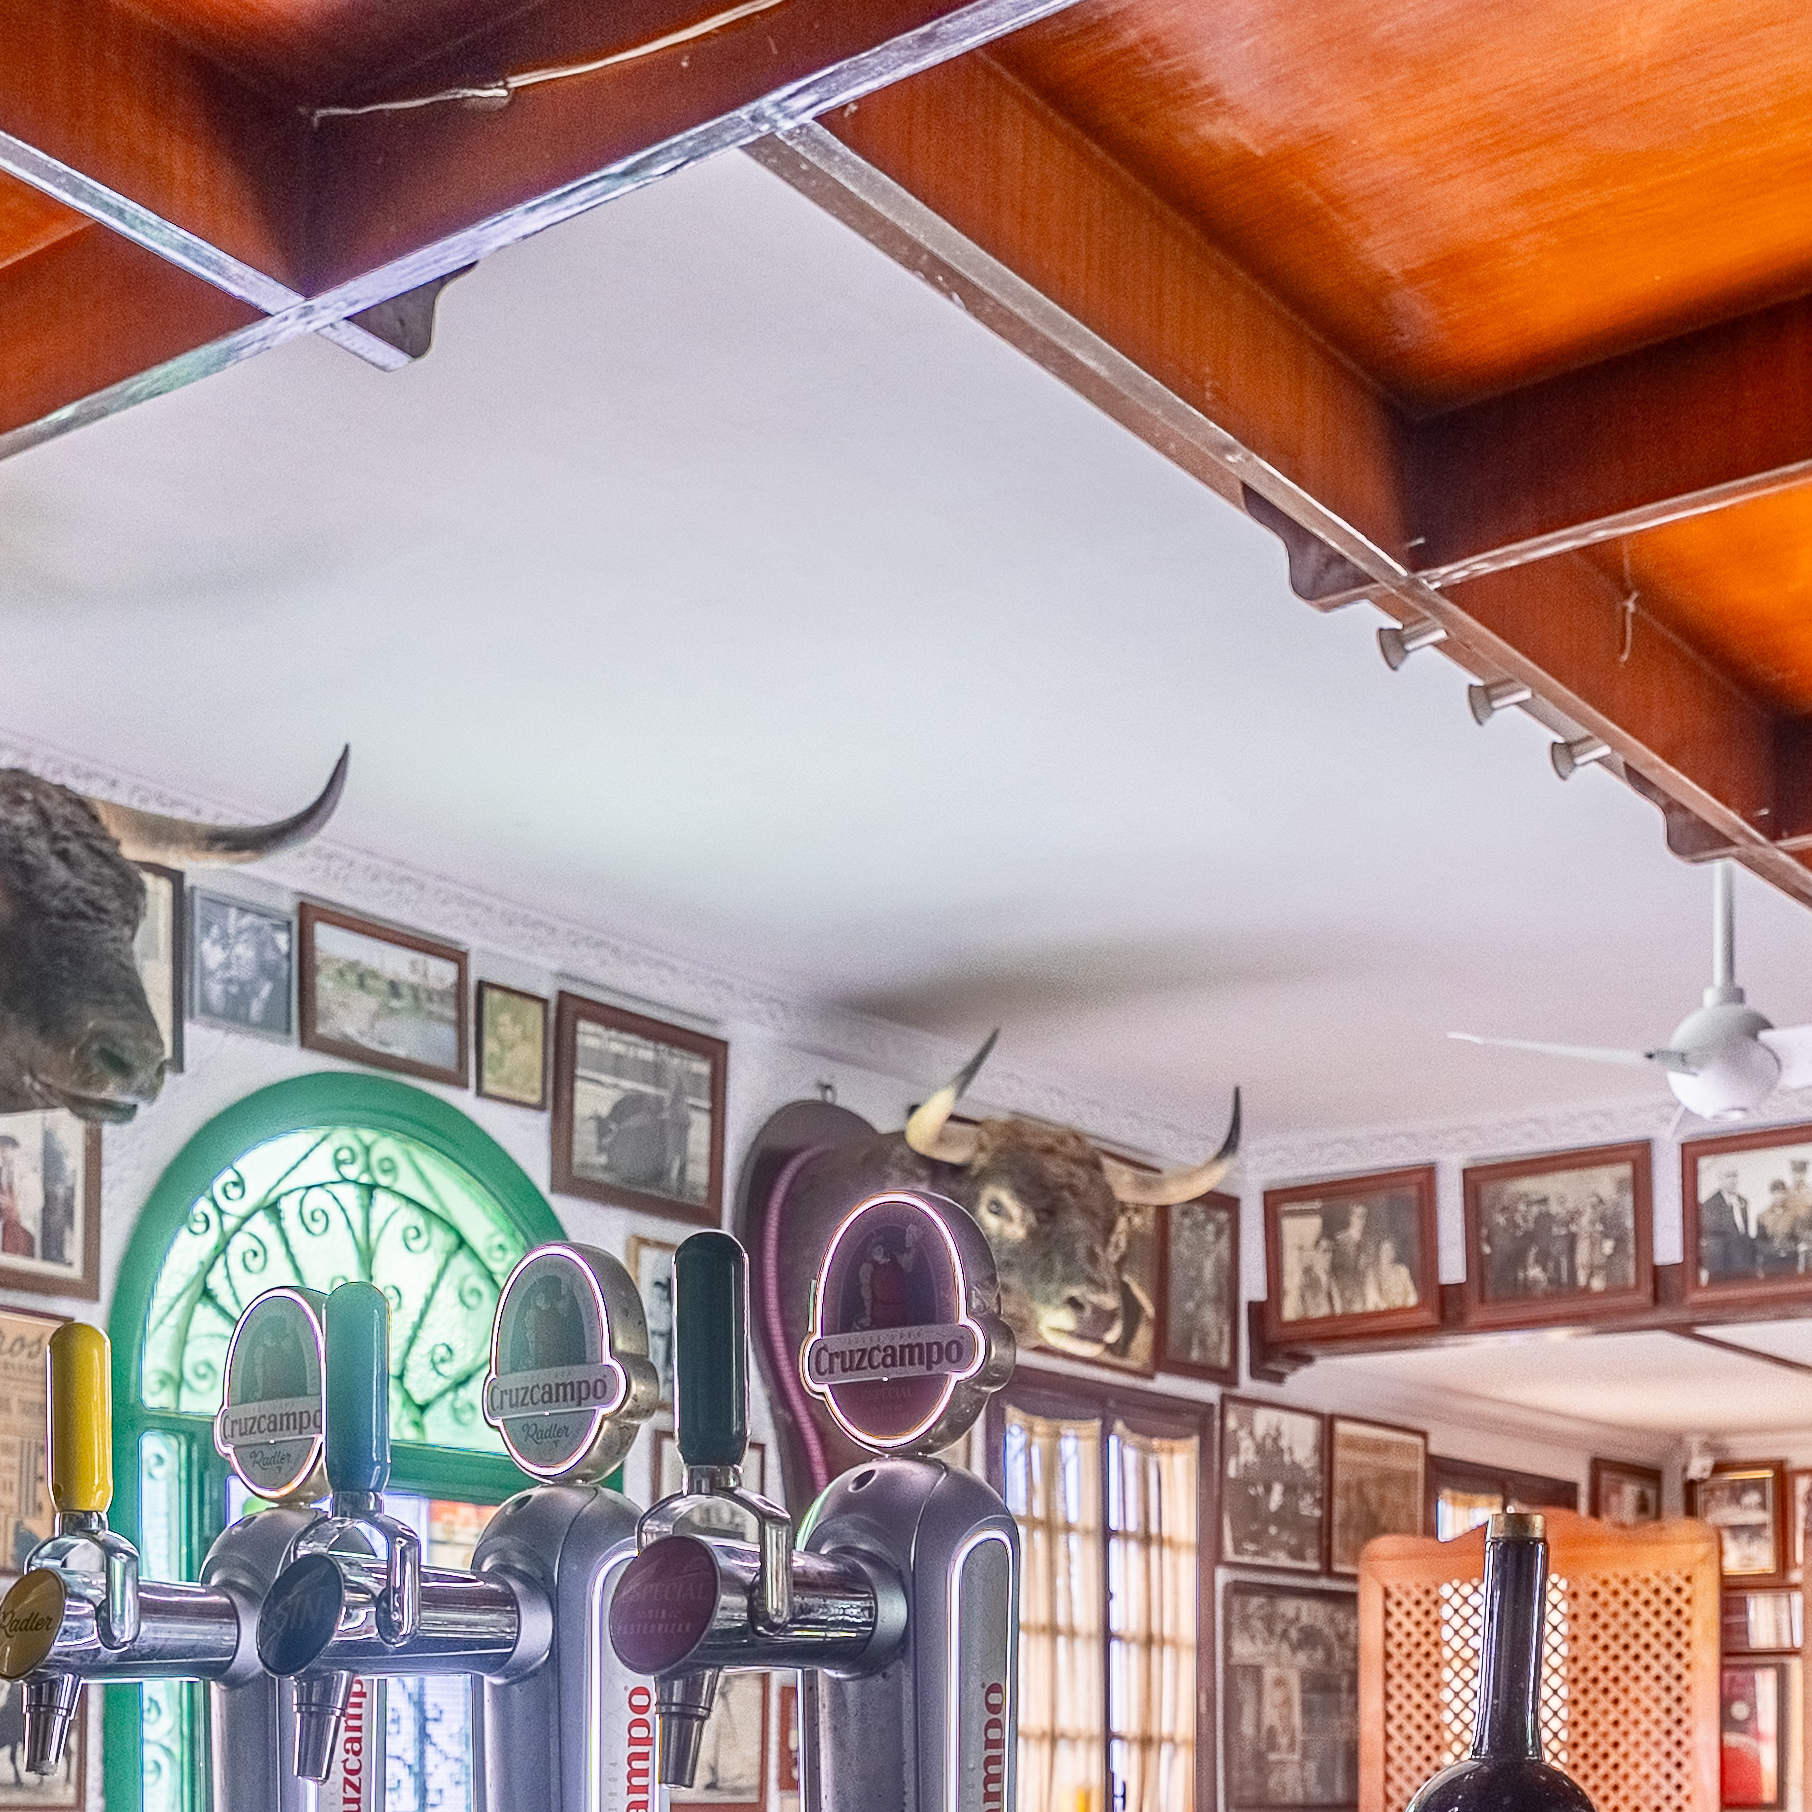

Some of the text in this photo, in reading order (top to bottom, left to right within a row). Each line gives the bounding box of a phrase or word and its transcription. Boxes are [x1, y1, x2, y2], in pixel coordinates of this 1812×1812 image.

[815, 1339, 964, 1376] Cruzcampo
[490, 1378, 607, 1411] Cruzcampo
[223, 1409, 322, 1439] Cruzcampo
[522, 1422, 570, 1445] Radler
[249, 1450, 291, 1470] Radler
